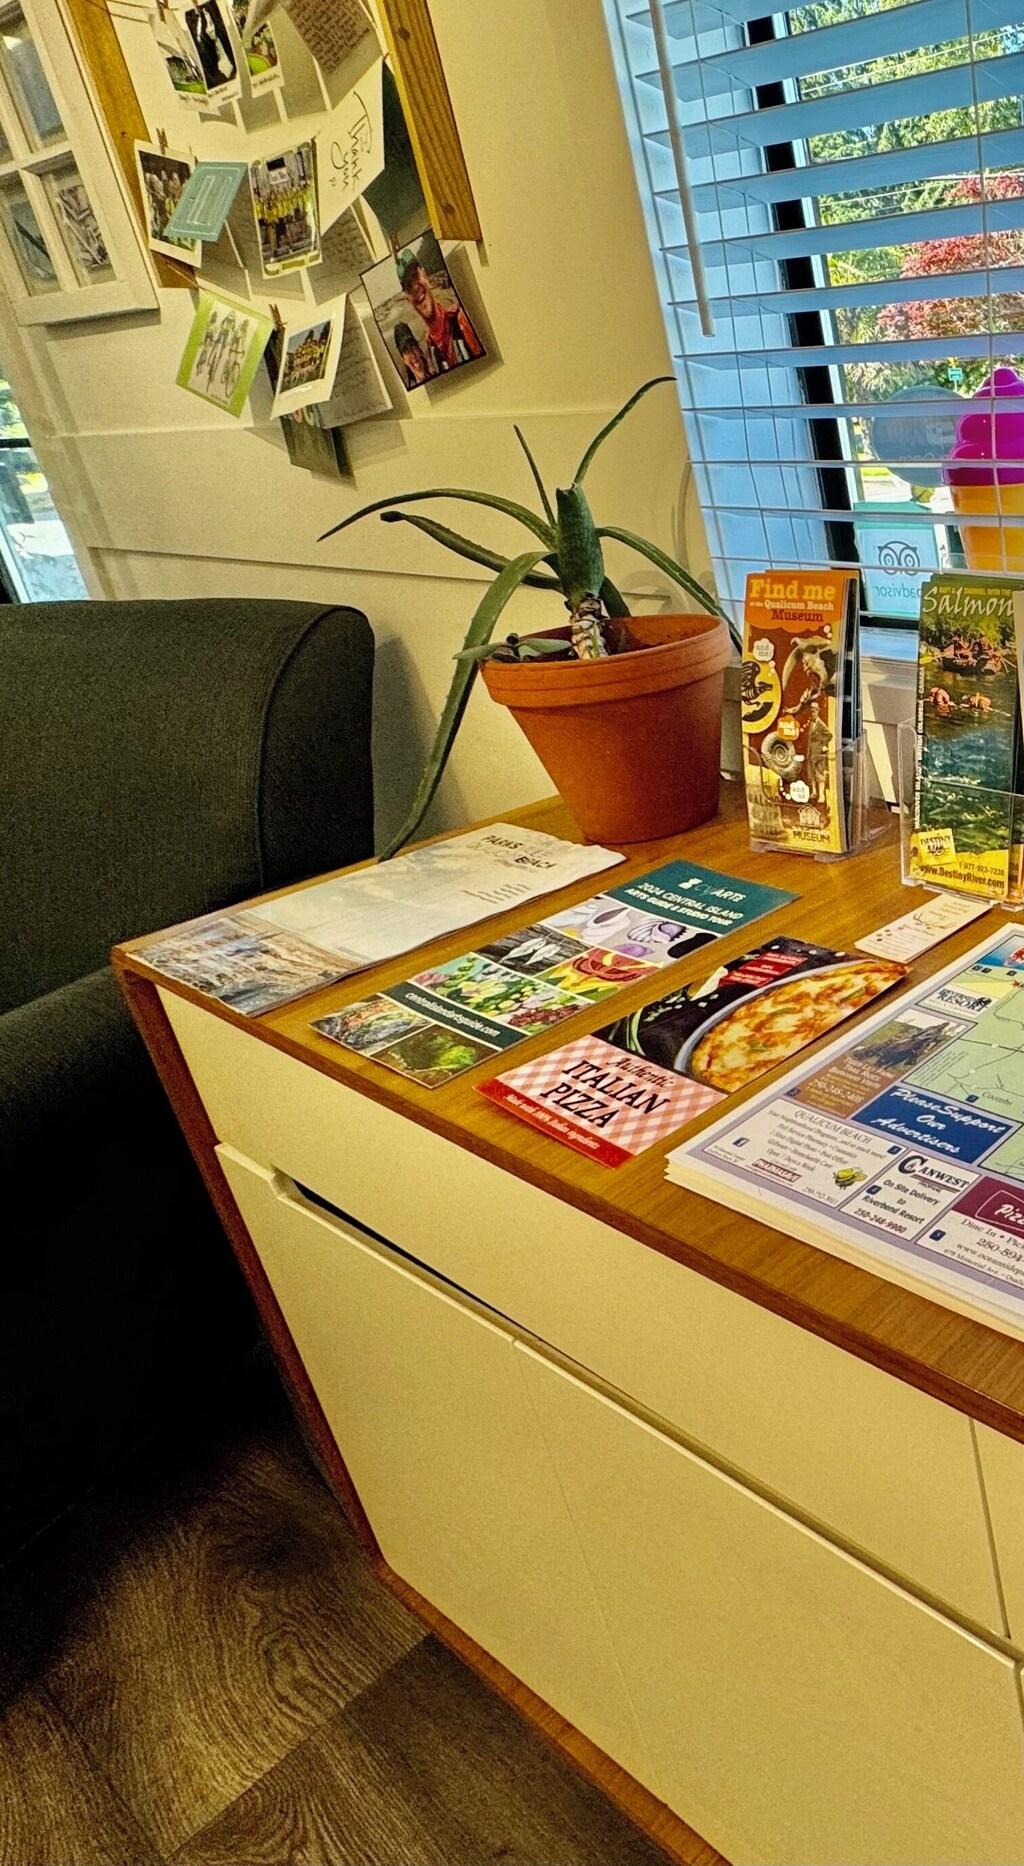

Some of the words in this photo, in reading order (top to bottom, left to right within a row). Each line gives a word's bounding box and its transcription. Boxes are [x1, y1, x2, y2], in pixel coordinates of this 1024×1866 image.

[750, 579, 799, 599] Find
[802, 584, 836, 600] me
[922, 586, 1014, 616] Salmon
[765, 600, 805, 609] Qualicum
[807, 602, 834, 610] Beach
[772, 610, 824, 622] Museum
[793, 830, 830, 842] MUSEUM
[624, 888, 645, 900] ARTS
[662, 891, 704, 911] CENTRAL
[705, 905, 744, 920] ISLAND
[562, 1060, 671, 1114] ITALIAN
[606, 1057, 676, 1089] Authentic
[540, 1082, 621, 1128] PIZZA
[891, 1088, 941, 1111] Please
[937, 1103, 1006, 1134] Support
[794, 1109, 840, 1133] QUALICUM
[841, 1127, 872, 1144] BEACH
[871, 1117, 960, 1154] Advertisers
[916, 1114, 946, 1130] Our
[898, 1155, 969, 1188] CANWEST
[883, 1179, 893, 1187] On
[894, 1183, 909, 1194] Site
[909, 1188, 940, 1206] Delivery
[862, 1195, 899, 1214] Riverbend
[900, 1209, 925, 1225] Resort
[961, 1217, 985, 1231] Dine
[986, 1228, 996, 1238] In
